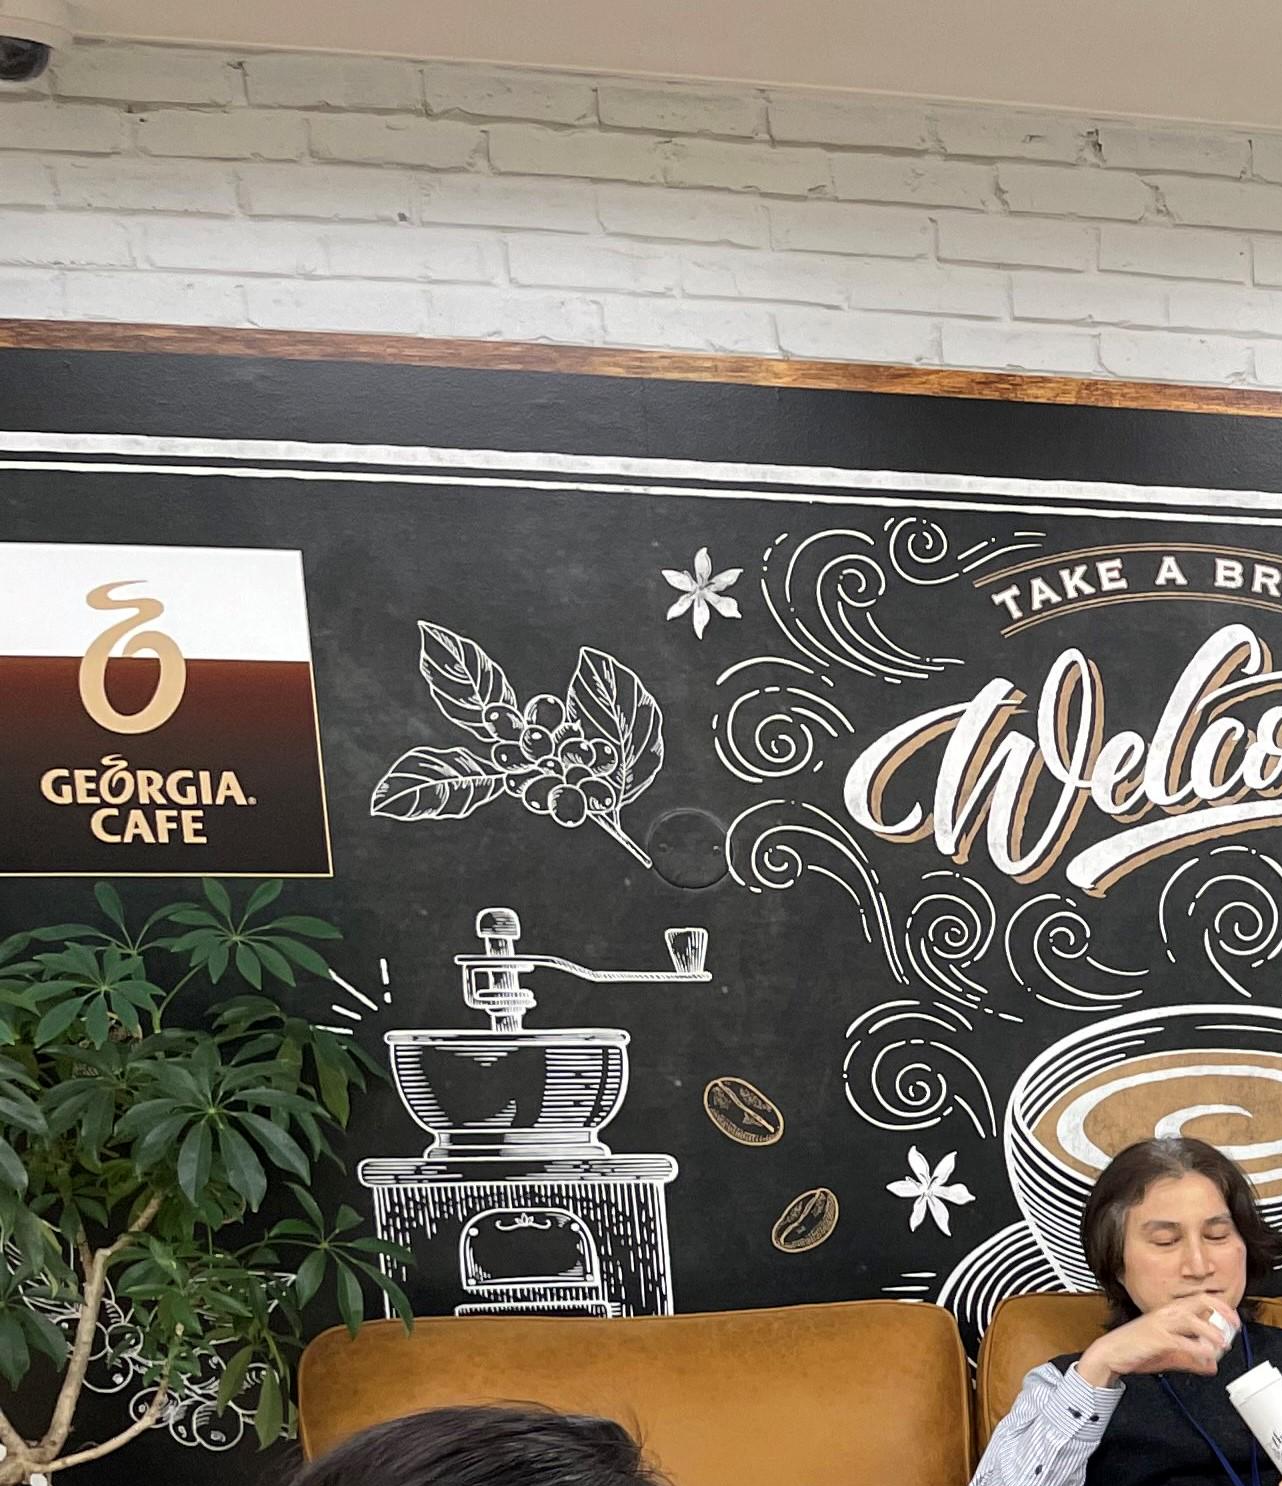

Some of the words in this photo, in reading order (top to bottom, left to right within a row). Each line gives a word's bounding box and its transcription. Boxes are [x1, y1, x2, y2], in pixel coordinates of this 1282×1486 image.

[992, 558, 1129, 620] TAKE
[1154, 556, 1188, 586] A
[40, 754, 248, 805] GEORGIA
[90, 807, 208, 844] CAFE
